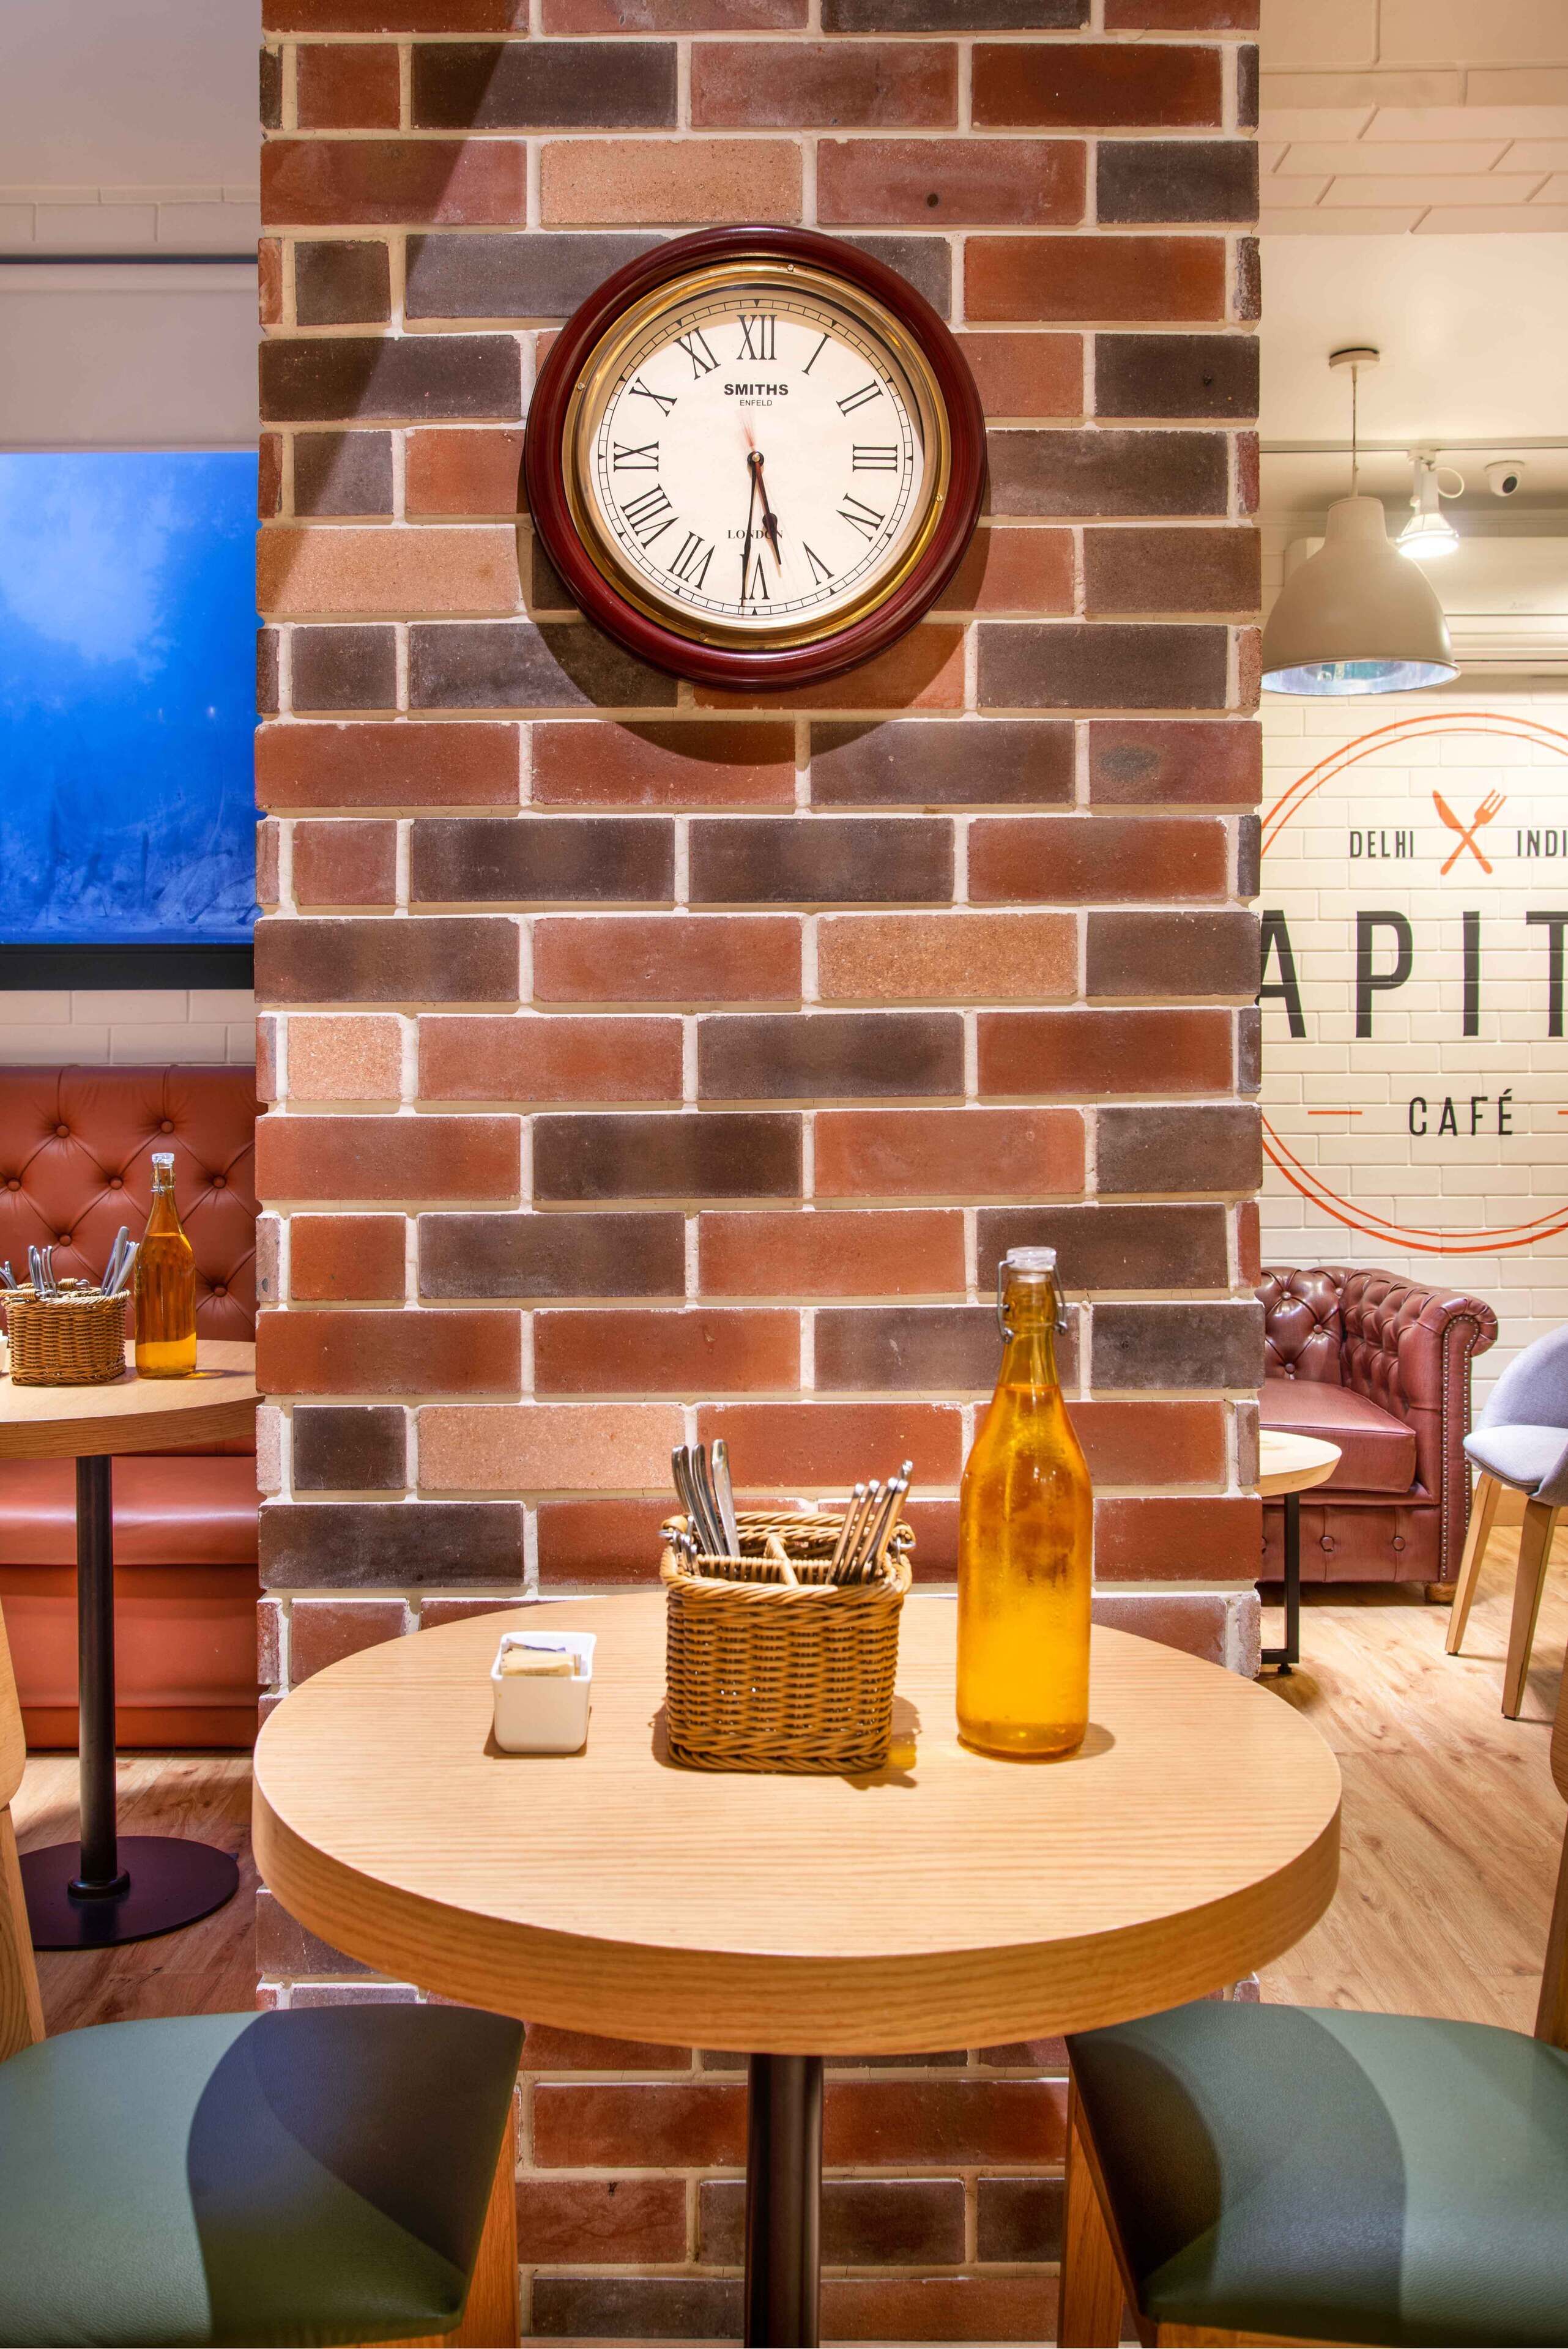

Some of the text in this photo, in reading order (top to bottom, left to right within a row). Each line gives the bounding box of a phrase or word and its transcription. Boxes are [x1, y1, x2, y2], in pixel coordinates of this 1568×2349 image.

[674, 326, 721, 380] XI
[737, 314, 778, 360] XII
[801, 332, 831, 375] I
[628, 377, 677, 417] X
[724, 384, 789, 395] SMITHS
[836, 379, 883, 417] II
[614, 441, 659, 472] IX
[853, 444, 897, 473] III
[620, 483, 679, 549] VIII
[836, 493, 885, 542] IV
[666, 531, 715, 590] VII
[803, 541, 834, 585] V
[1350, 830, 1567, 858] DELHI INDI
[1255, 910, 1568, 1038] APIT
[1408, 1089, 1514, 1136] CAFÉ
